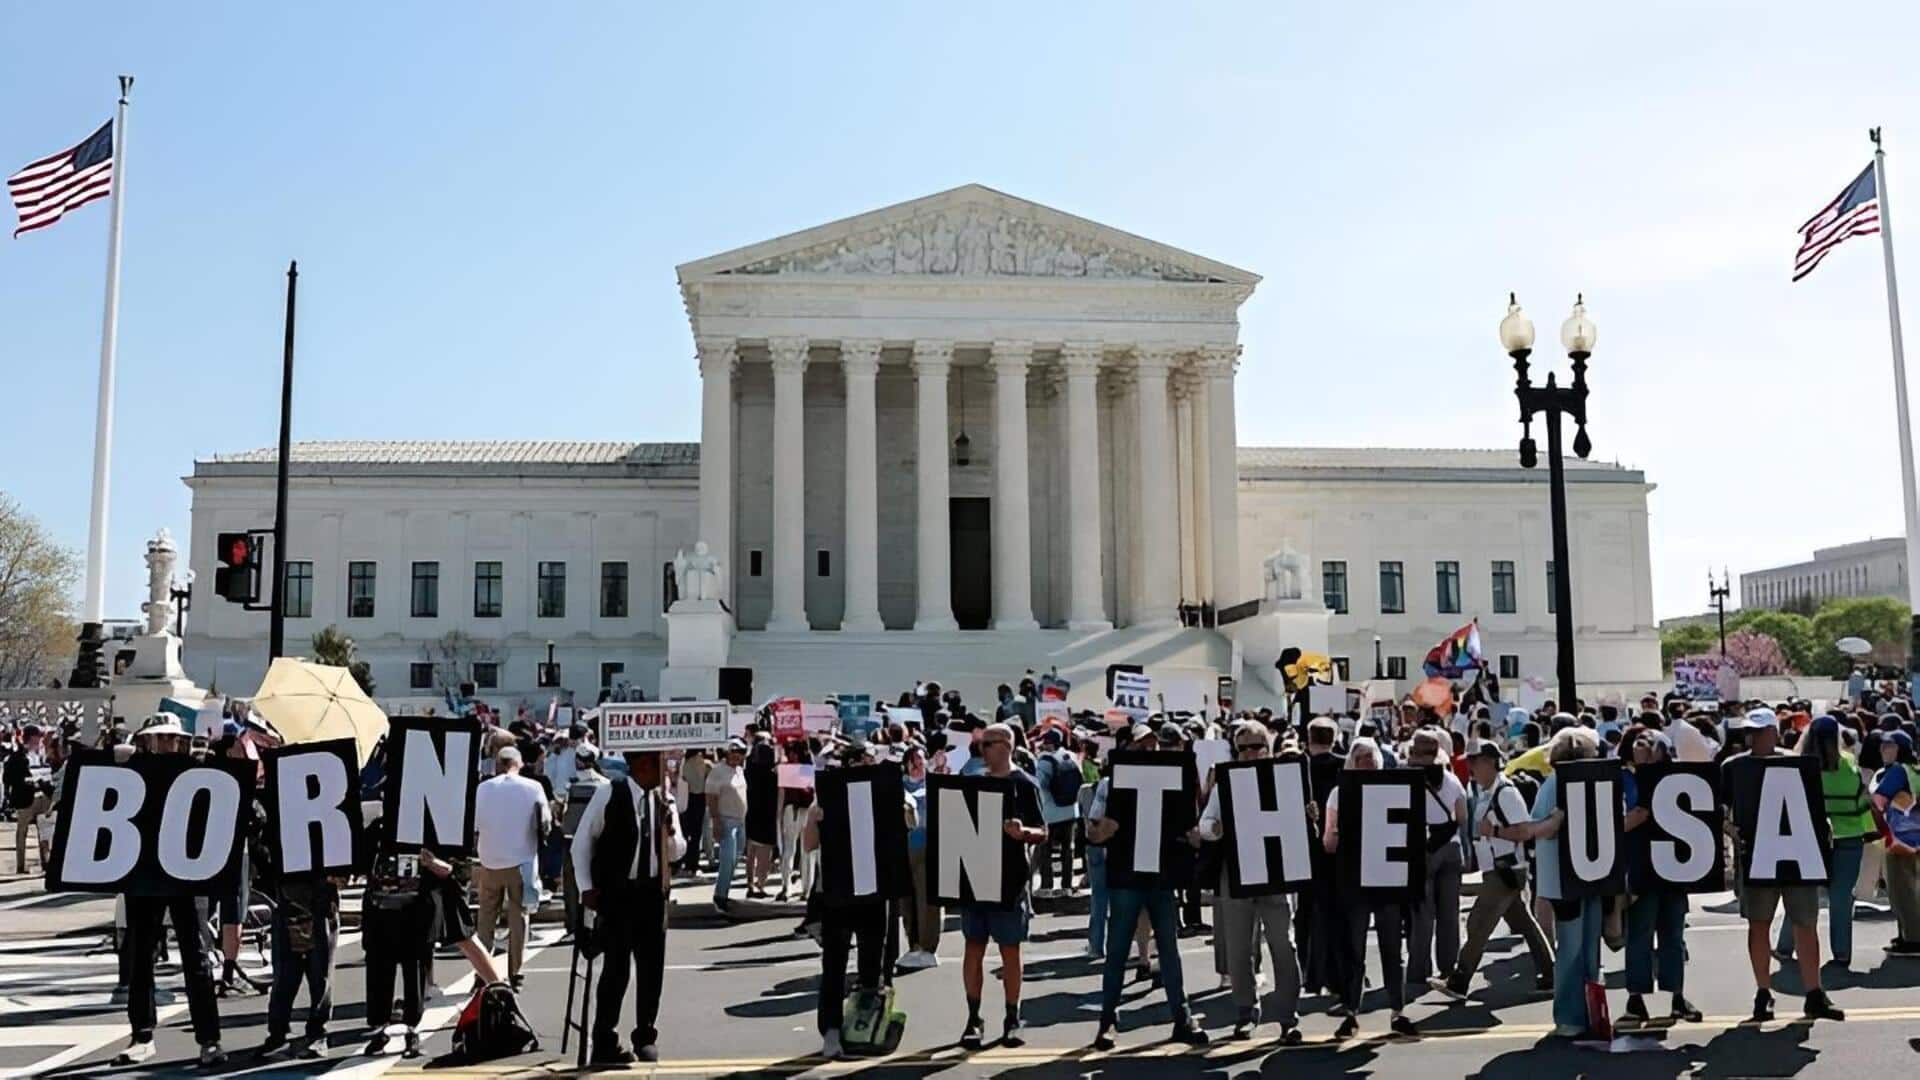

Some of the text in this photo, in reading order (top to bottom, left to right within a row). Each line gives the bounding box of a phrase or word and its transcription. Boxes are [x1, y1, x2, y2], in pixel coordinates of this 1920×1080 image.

[62, 730, 1828, 902] BORN IN THE USA
